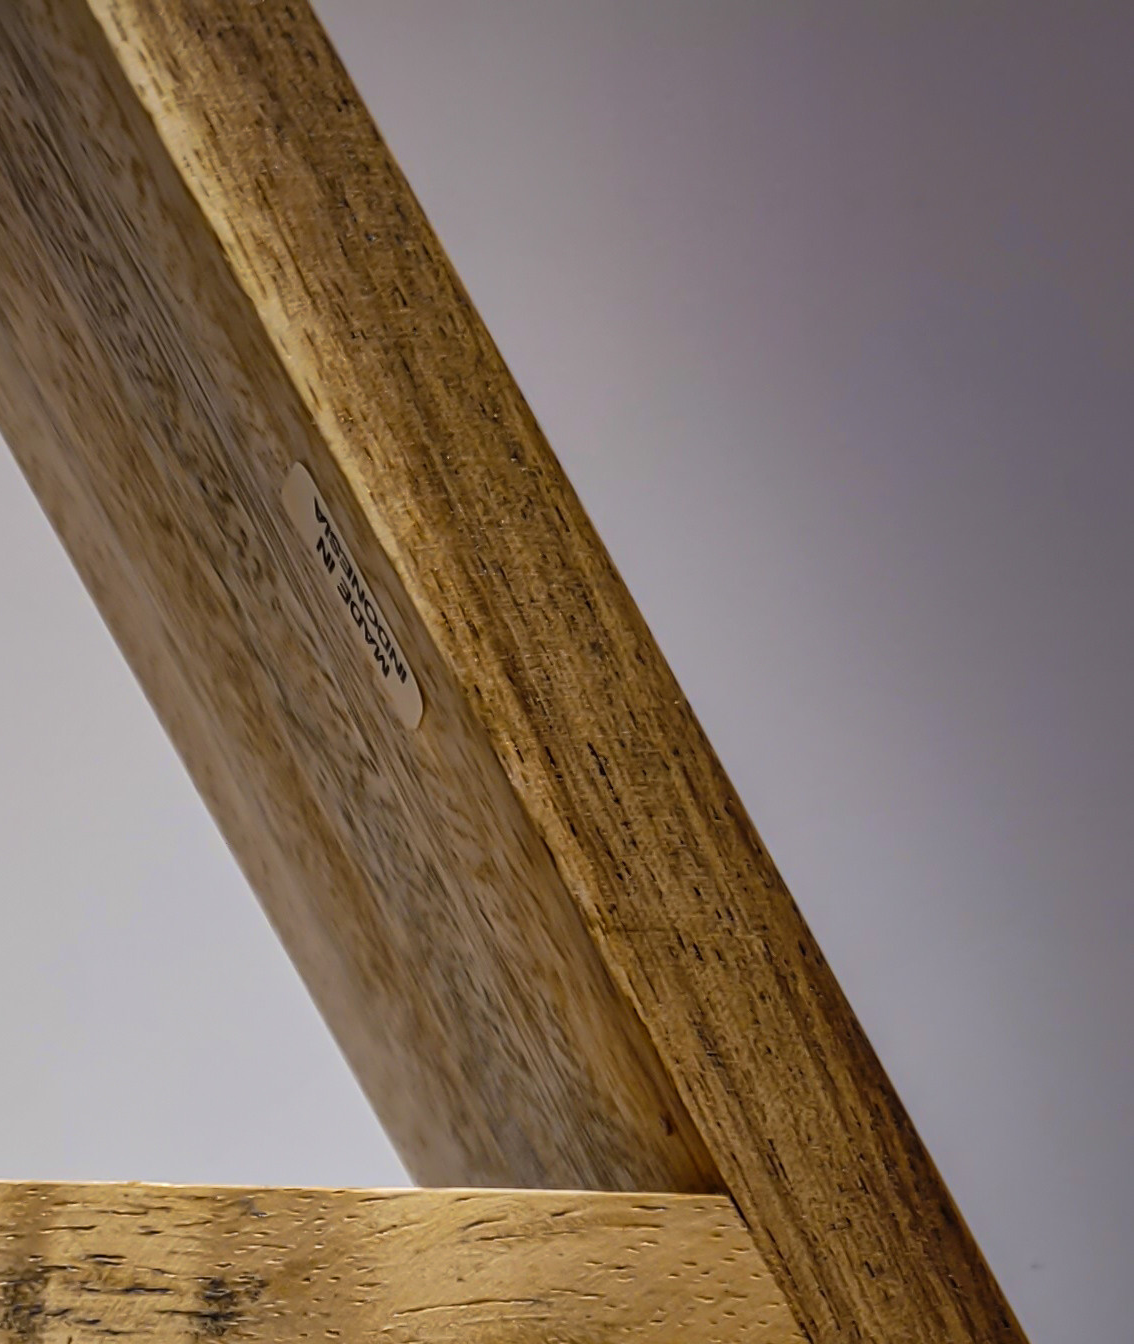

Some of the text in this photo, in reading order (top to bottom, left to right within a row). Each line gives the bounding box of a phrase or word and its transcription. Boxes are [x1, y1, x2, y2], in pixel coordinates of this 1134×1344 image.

[314, 496, 407, 684] INDONESIA
[316, 536, 390, 679] MADE IN
